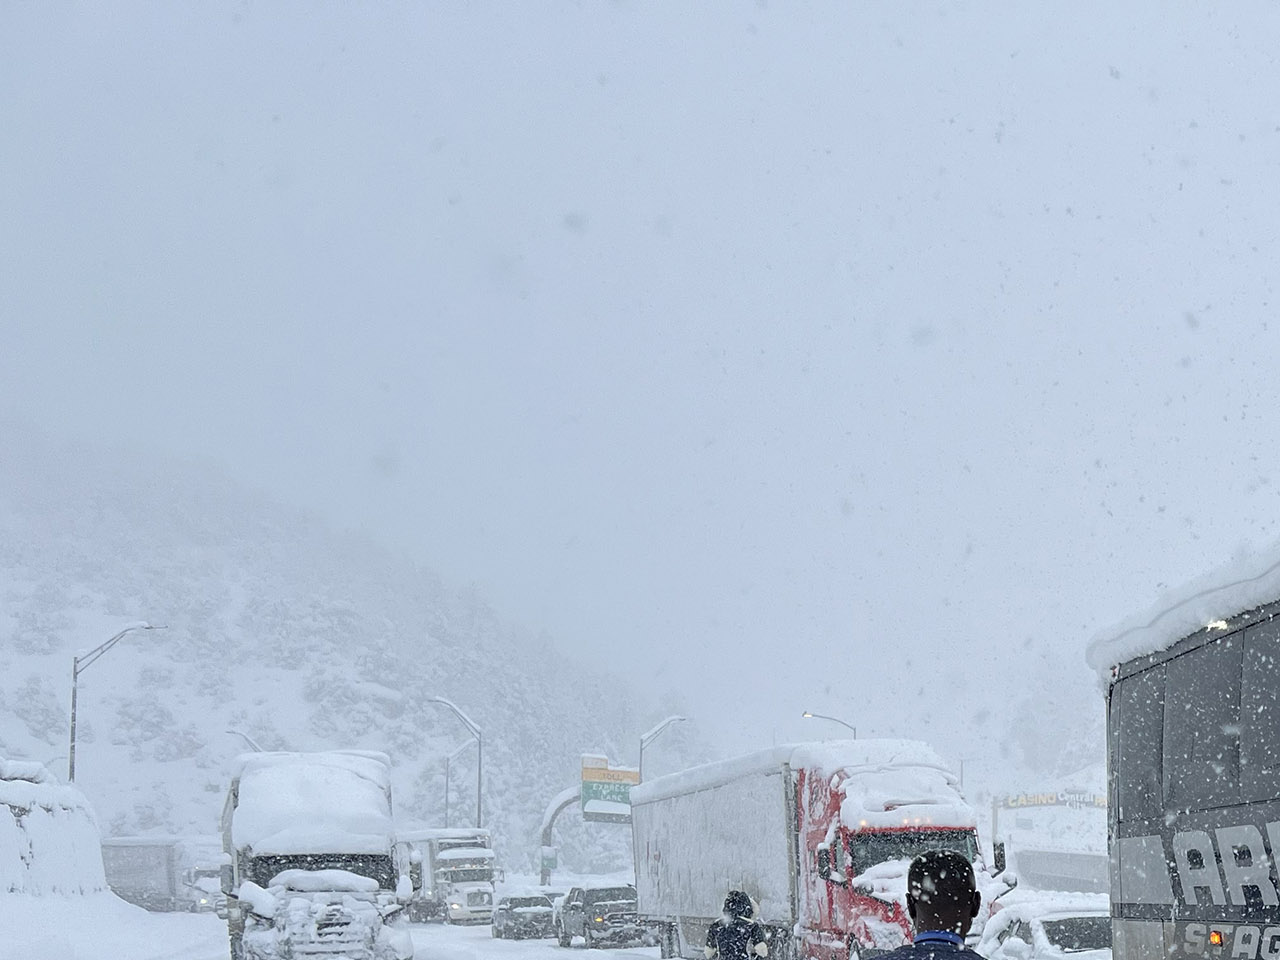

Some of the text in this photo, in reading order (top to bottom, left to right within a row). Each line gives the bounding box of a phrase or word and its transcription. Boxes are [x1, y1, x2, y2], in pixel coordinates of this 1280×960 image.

[602, 772, 624, 781] TOLL
[592, 783, 632, 793] EXPRESS
[1007, 792, 1057, 808] CASINO
[1058, 792, 1095, 803] Central
